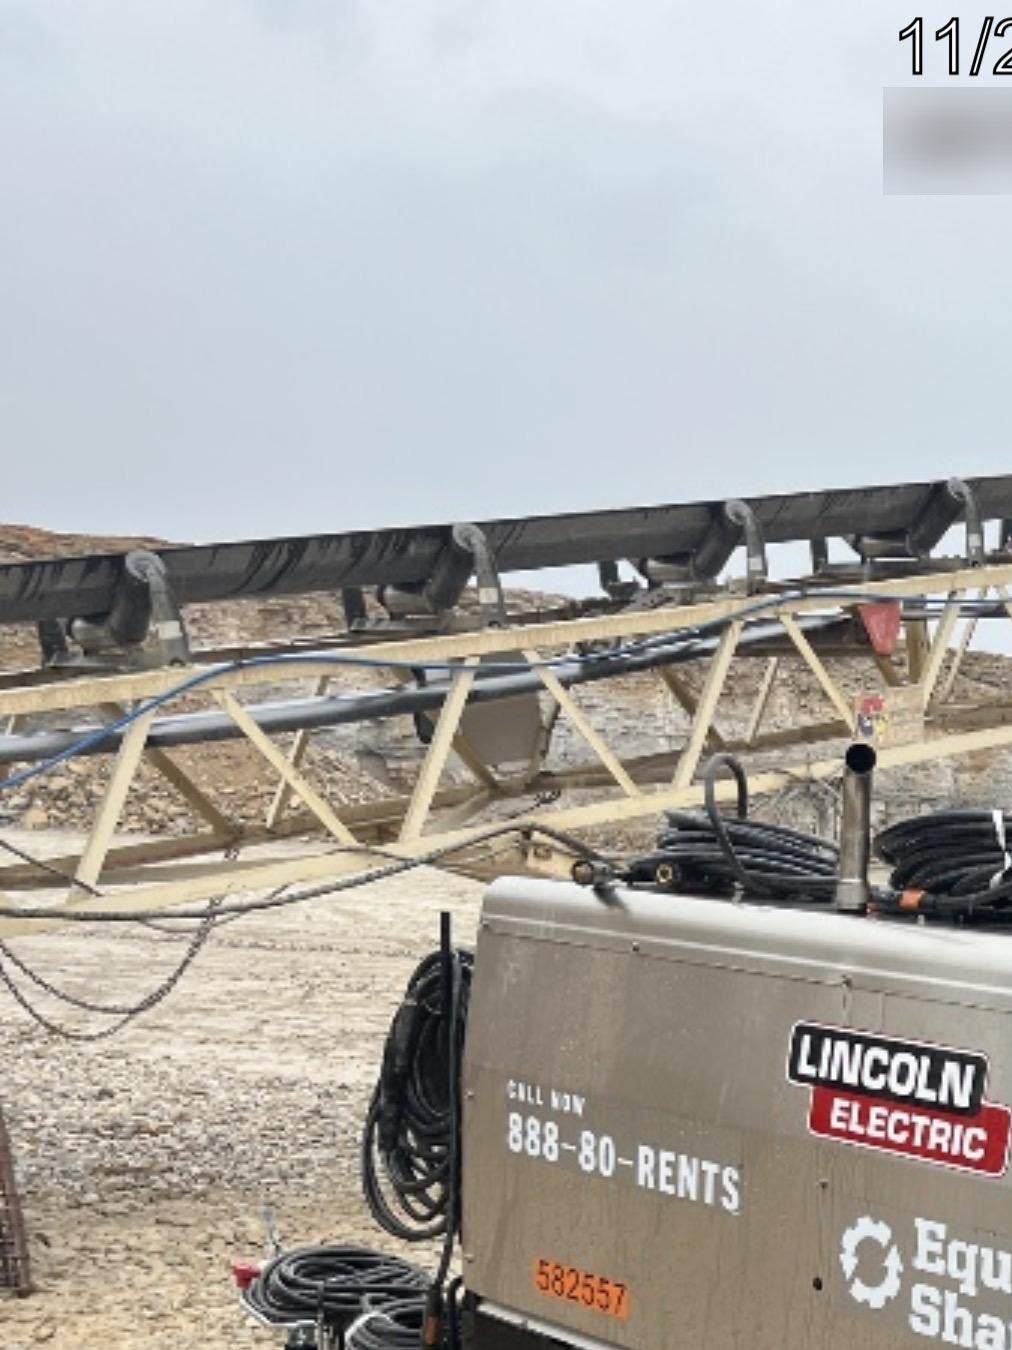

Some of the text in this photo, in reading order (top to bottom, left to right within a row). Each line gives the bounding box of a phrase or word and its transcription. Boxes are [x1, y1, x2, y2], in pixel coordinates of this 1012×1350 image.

[506, 1078, 587, 1117] CALL NOW
[797, 1033, 976, 1109] LINCOLN
[508, 1111, 741, 1212] 888-80-RENTS
[829, 1097, 989, 1162] ELECTRIC
[535, 1258, 627, 1315] 582557
